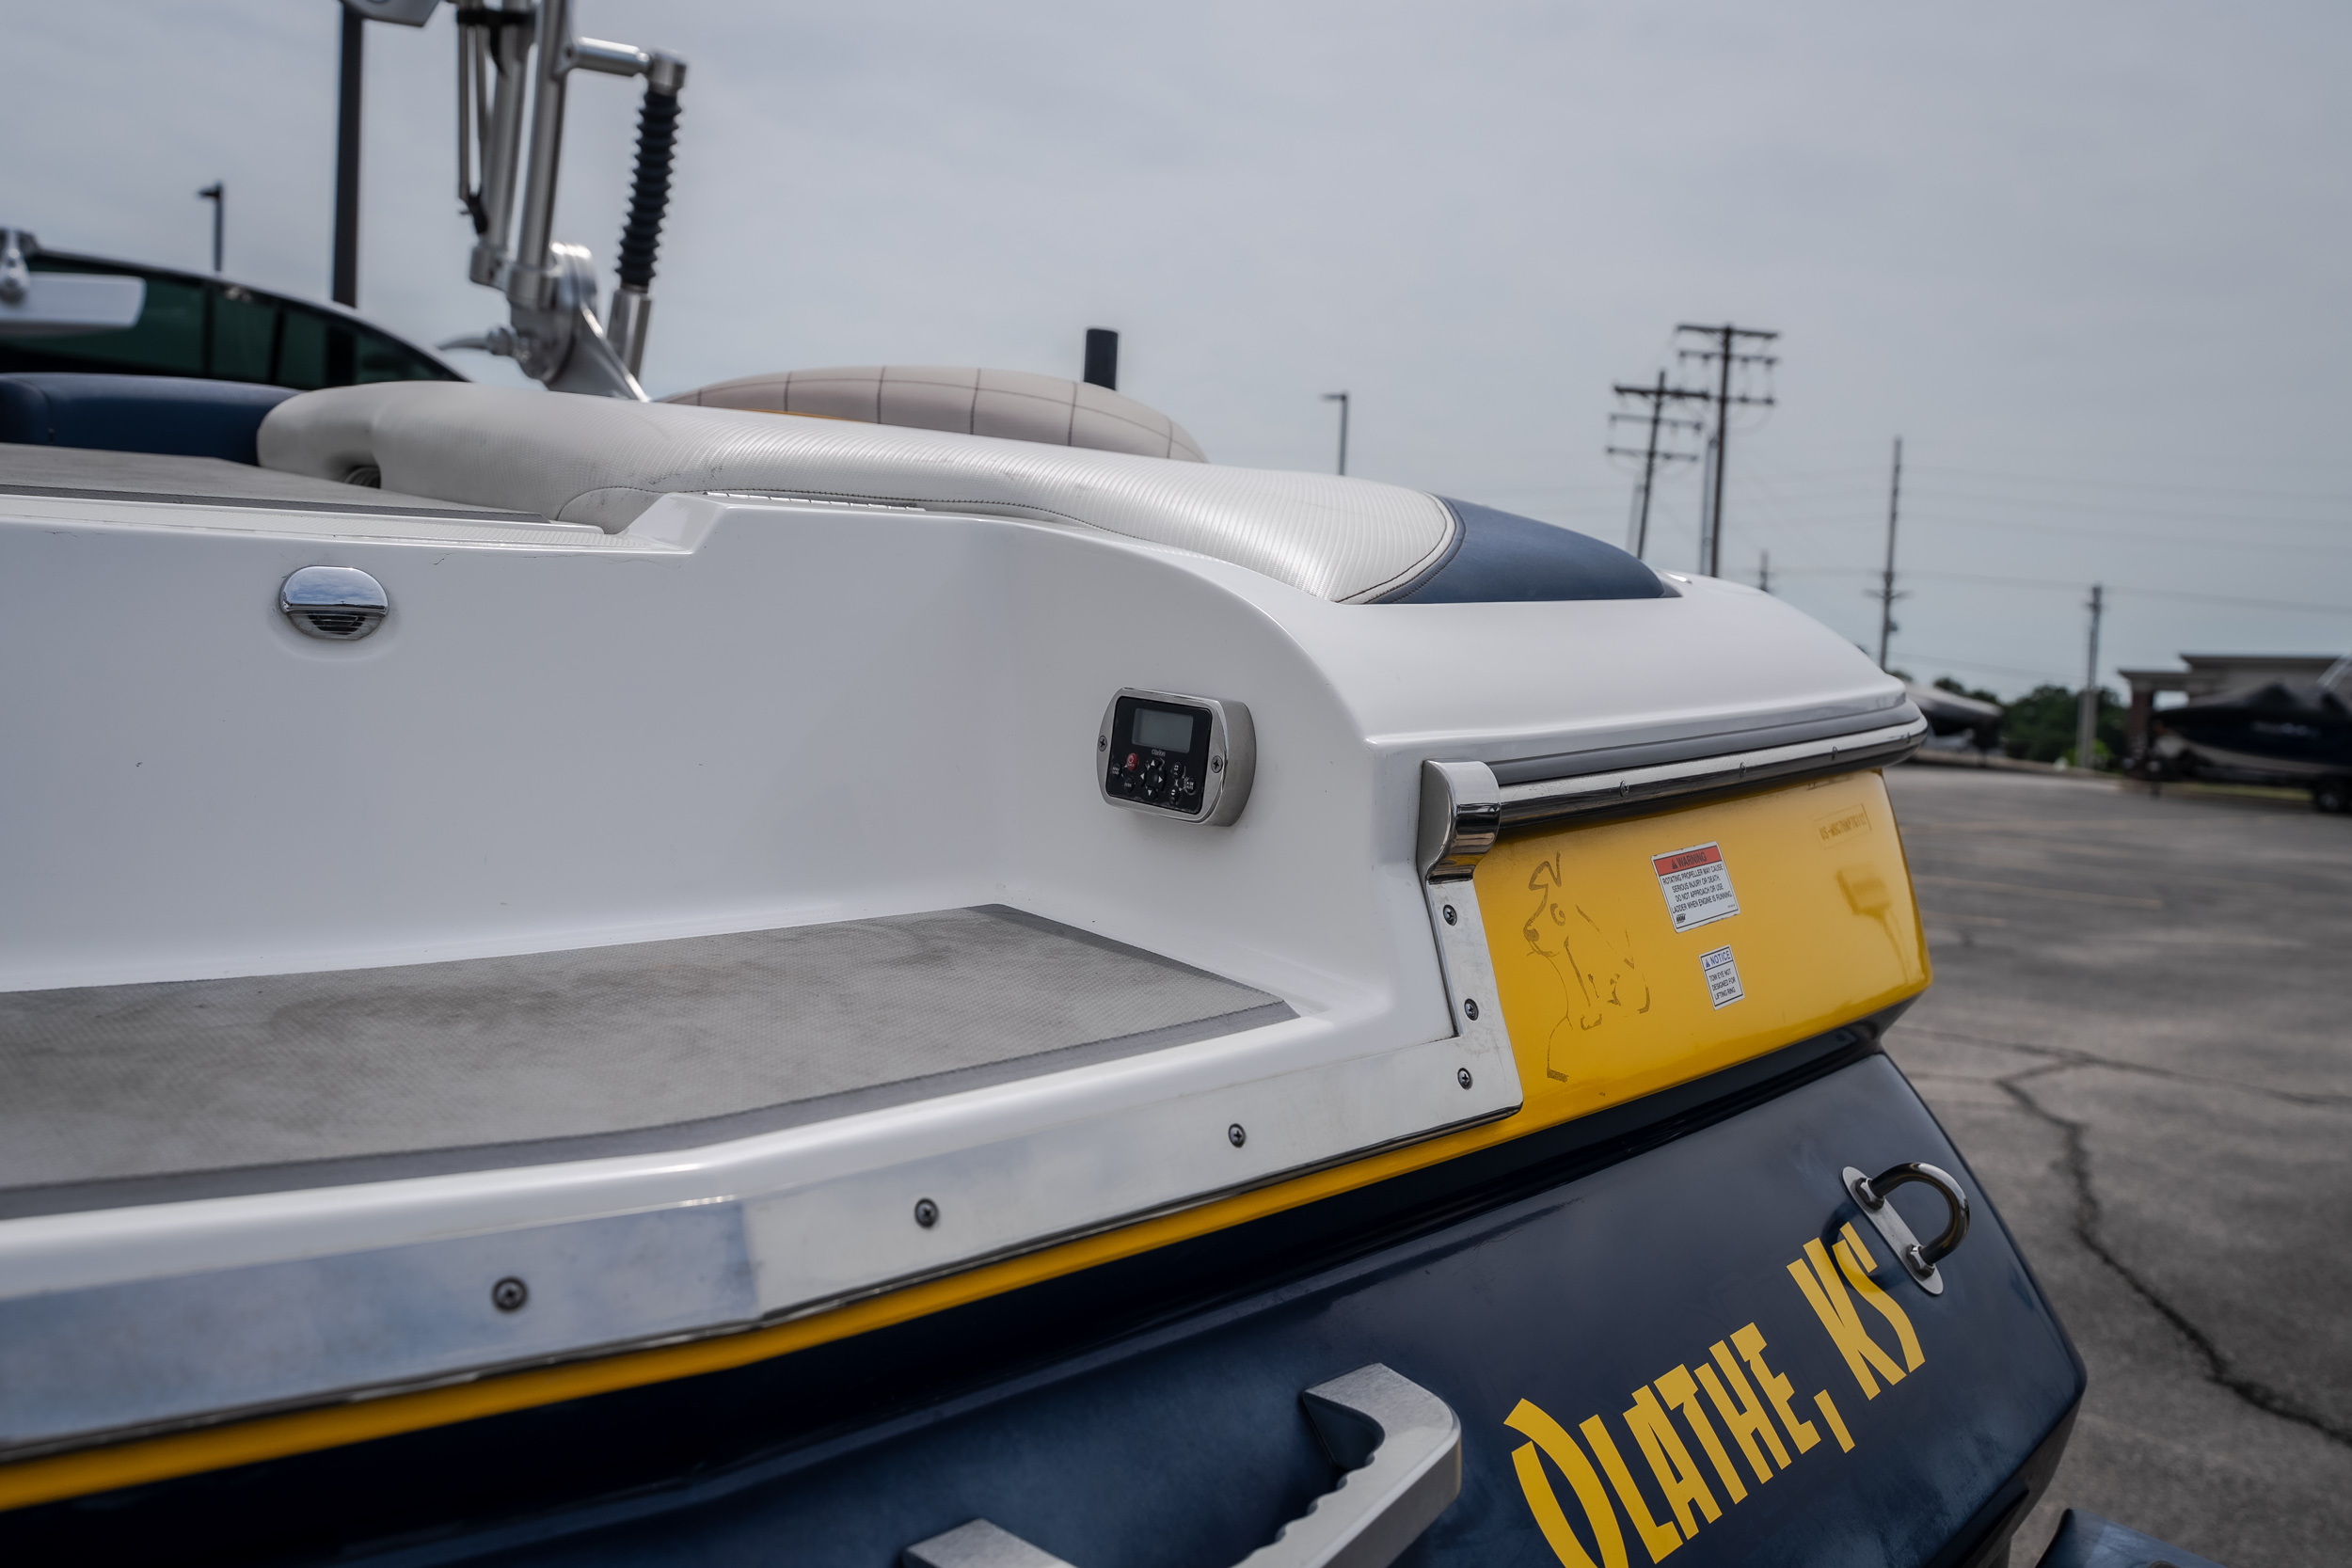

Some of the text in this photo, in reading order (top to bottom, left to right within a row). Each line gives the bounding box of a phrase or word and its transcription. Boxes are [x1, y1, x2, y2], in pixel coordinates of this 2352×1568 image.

[1151, 749, 1166, 757] clarion
[1676, 851, 1708, 868] WARNING
[1661, 874, 1682, 885] ROTATING
[1681, 868, 1703, 879] PROPELLER
[1709, 863, 1724, 873] CAUSE
[1671, 874, 1721, 894] SERIOUS INJURY OR DEATH.
[1675, 895, 1682, 903] DO
[1681, 892, 1691, 900] NOT
[1690, 886, 1710, 898] APPROACH
[1715, 882, 1724, 891] USE
[1671, 903, 1688, 914] LADDER
[1687, 899, 1699, 910] WHEN
[1697, 895, 1712, 907] ENGINE
[1709, 950, 1731, 965] NOTICE
[1711, 979, 1729, 991] DESIGNED
[1714, 986, 1736, 1000] LIFTING RING
[1502, 1221, 1926, 1568] OLATHE, KS
